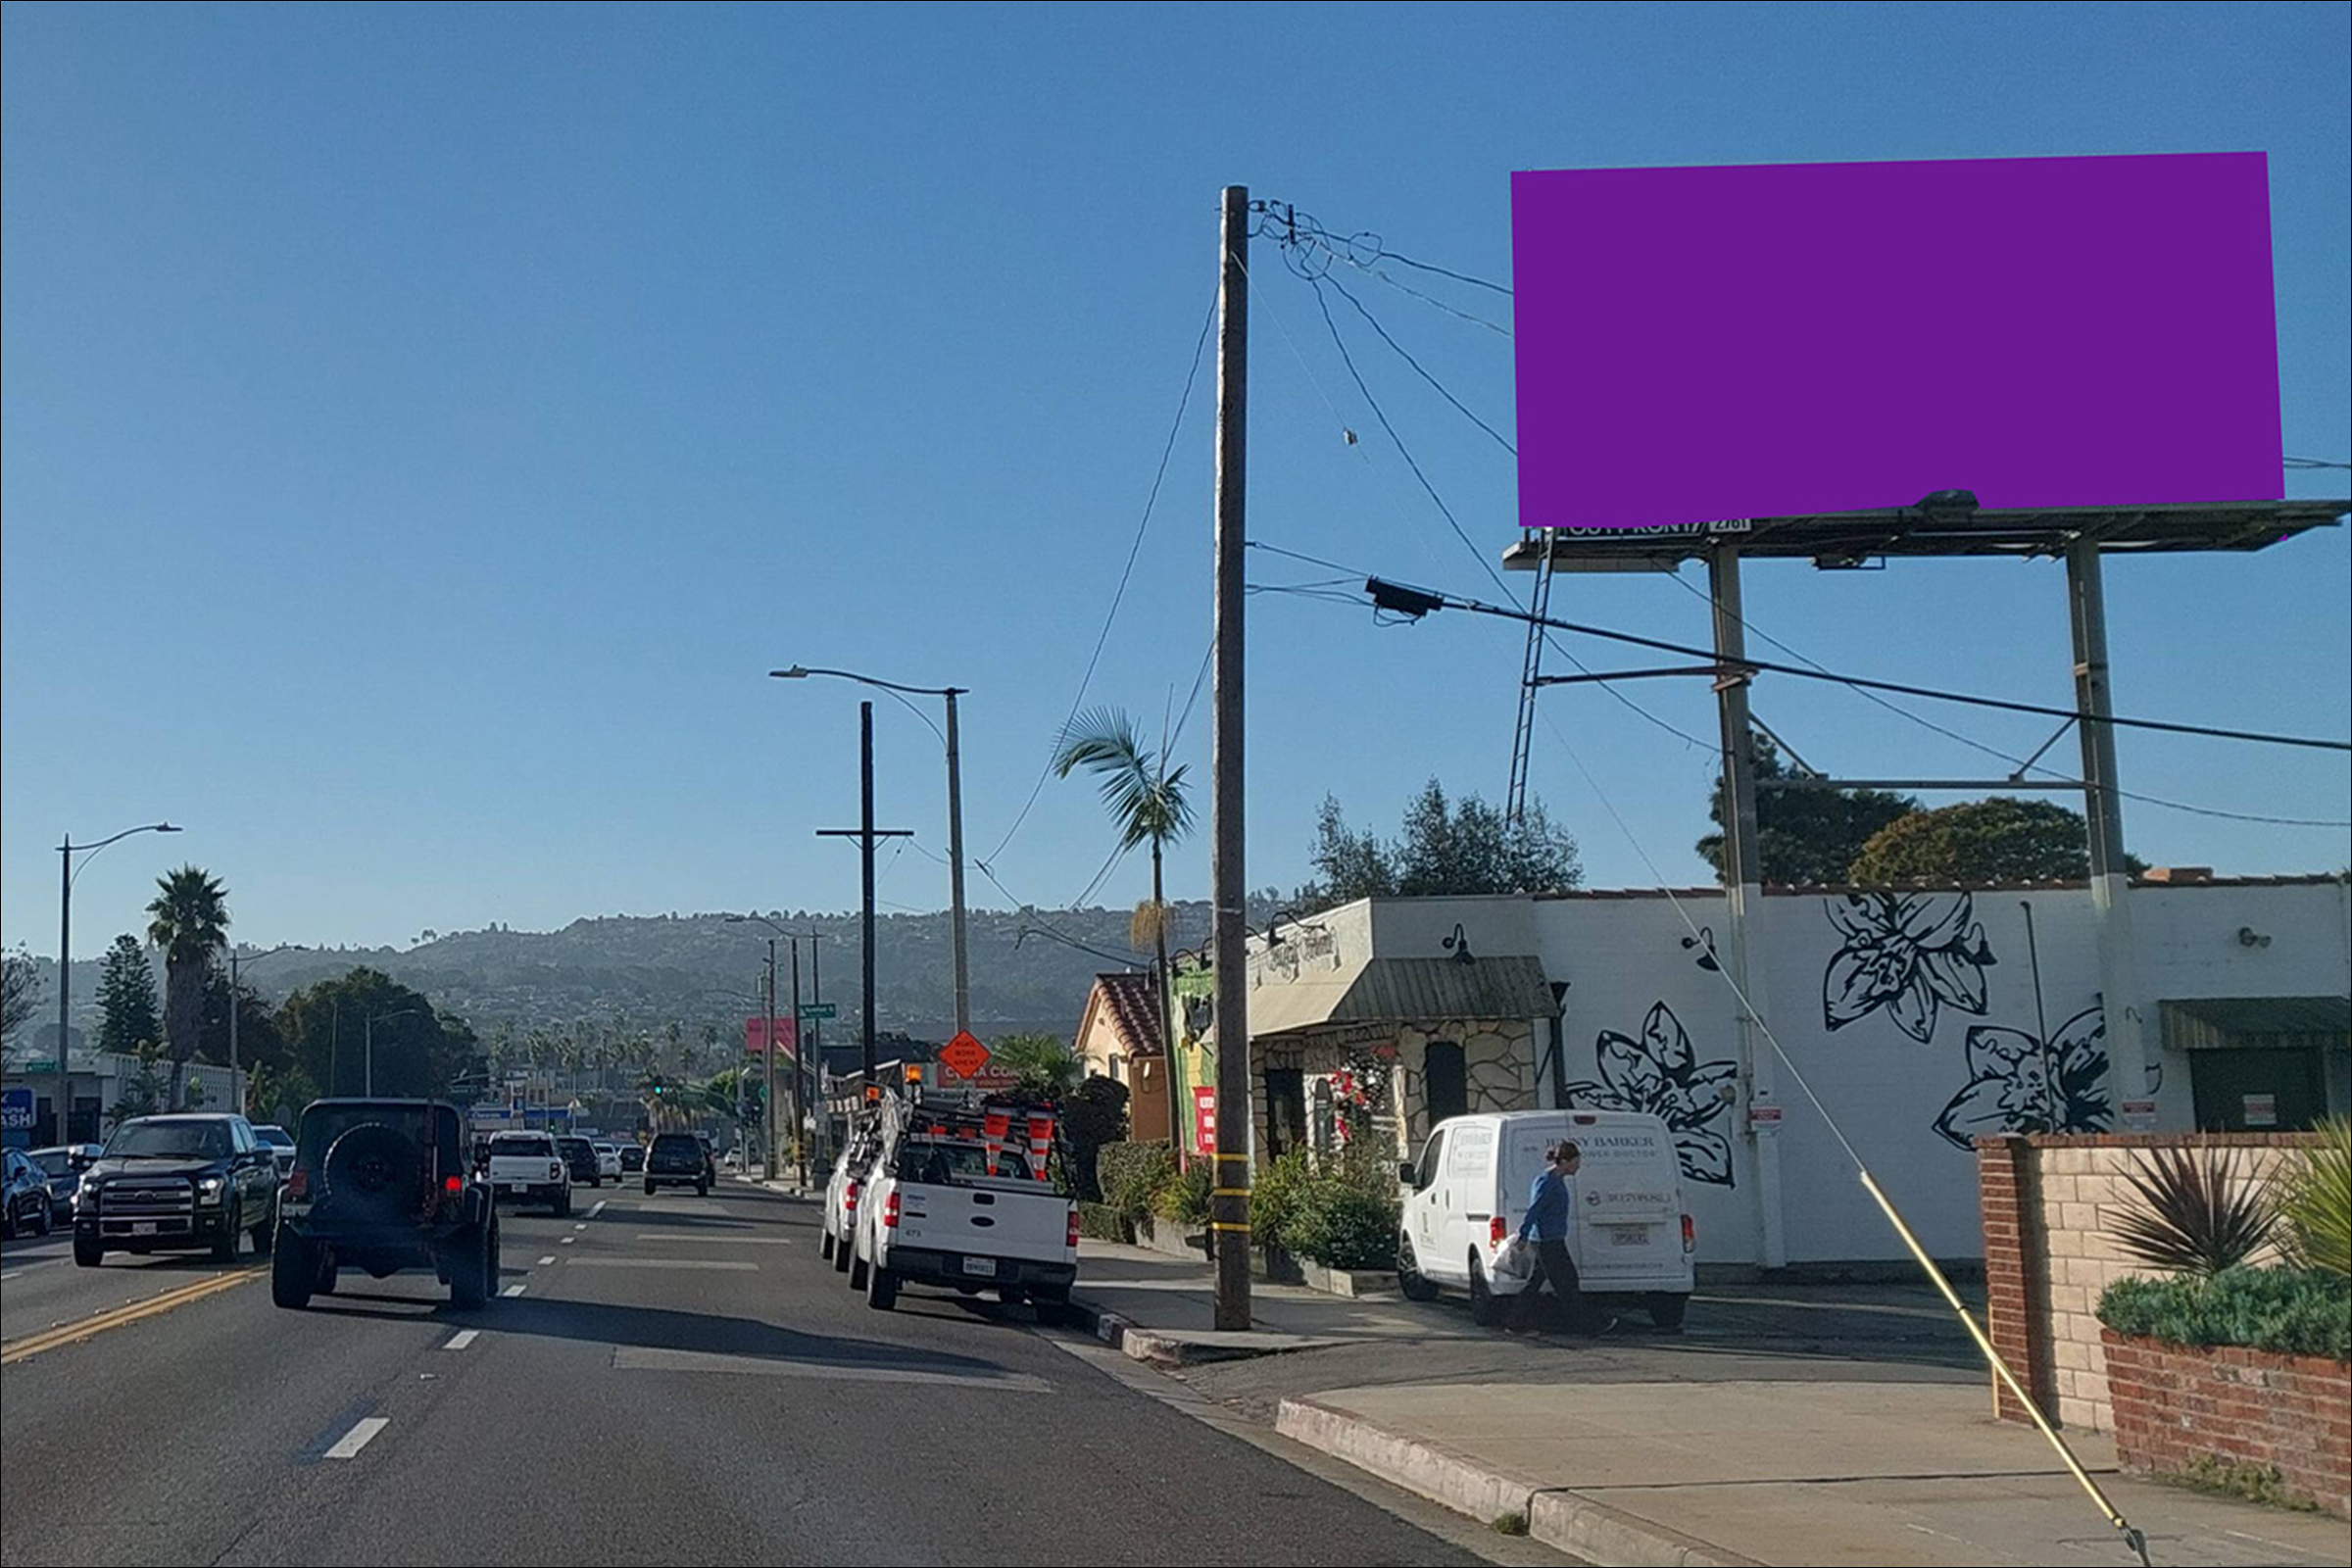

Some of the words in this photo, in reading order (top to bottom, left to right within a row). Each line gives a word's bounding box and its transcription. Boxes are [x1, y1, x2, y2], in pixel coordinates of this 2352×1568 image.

[1, 1113, 30, 1126] ASH
[1545, 1137, 1590, 1148] JENY
[1594, 1137, 1654, 1148] BARKER
